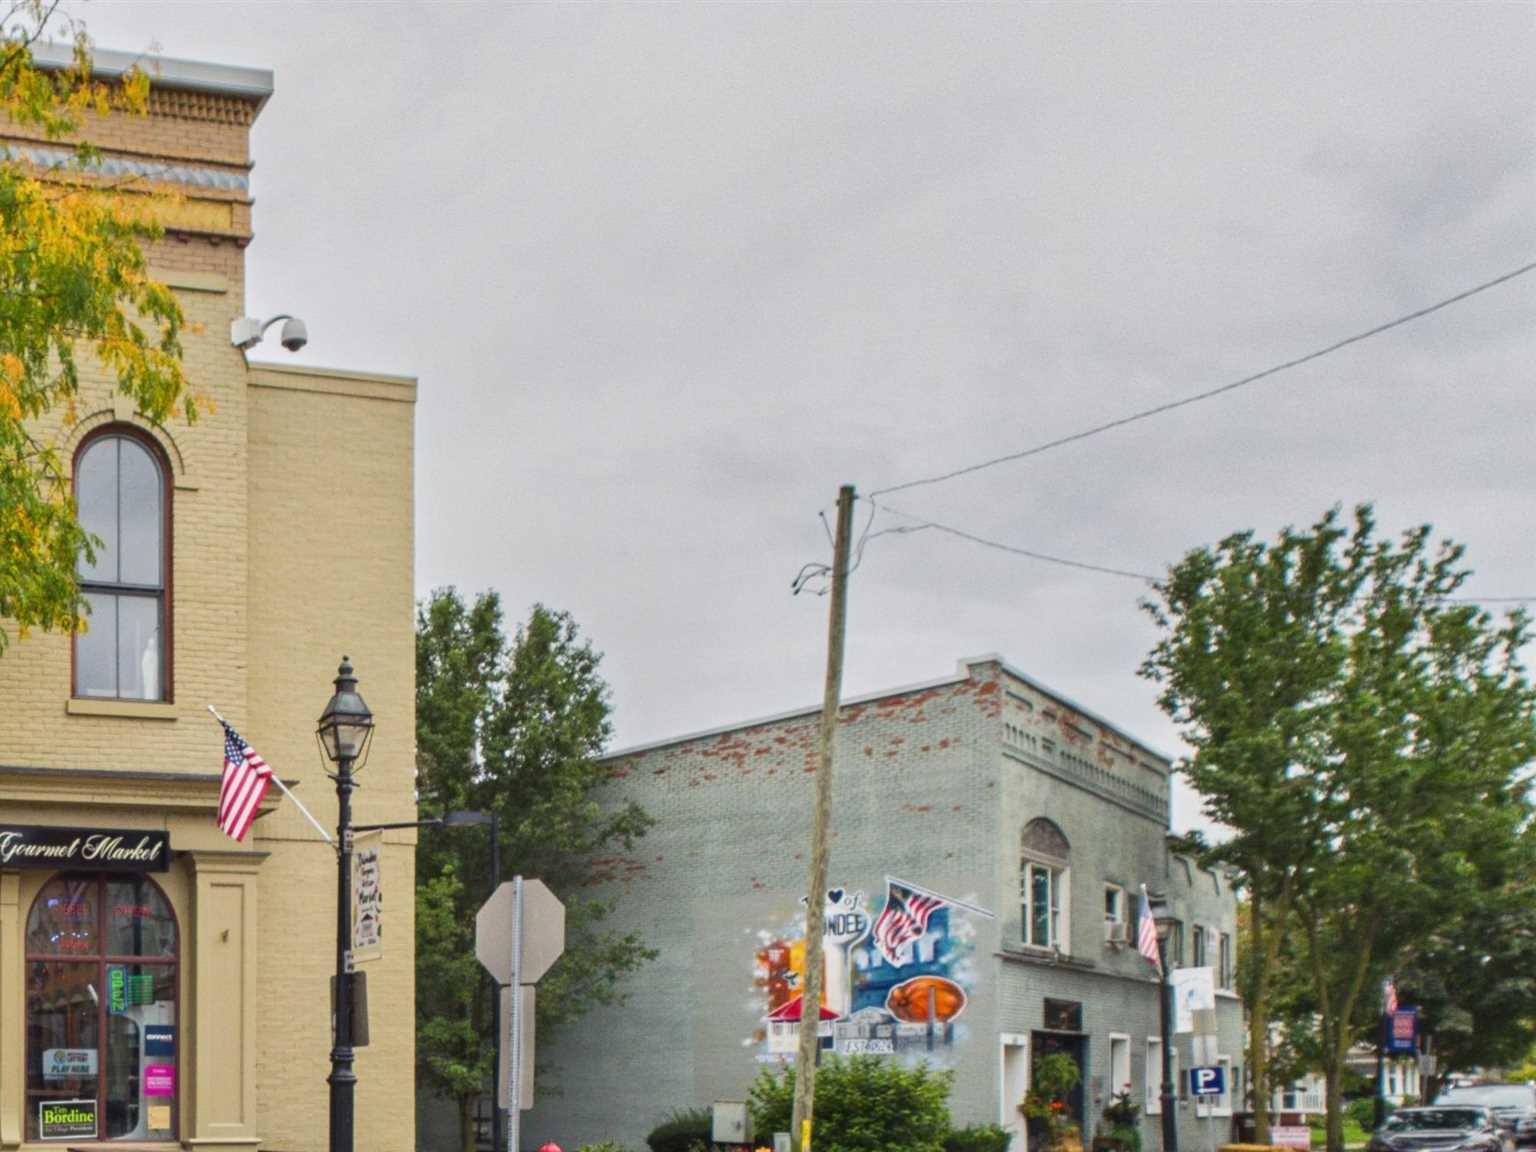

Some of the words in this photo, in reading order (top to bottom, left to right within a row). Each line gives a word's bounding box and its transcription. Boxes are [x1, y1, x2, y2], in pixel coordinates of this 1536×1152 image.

[81, 834, 162, 861] Market
[824, 913, 863, 936] NDEE
[45, 1108, 94, 1123] Bordine
